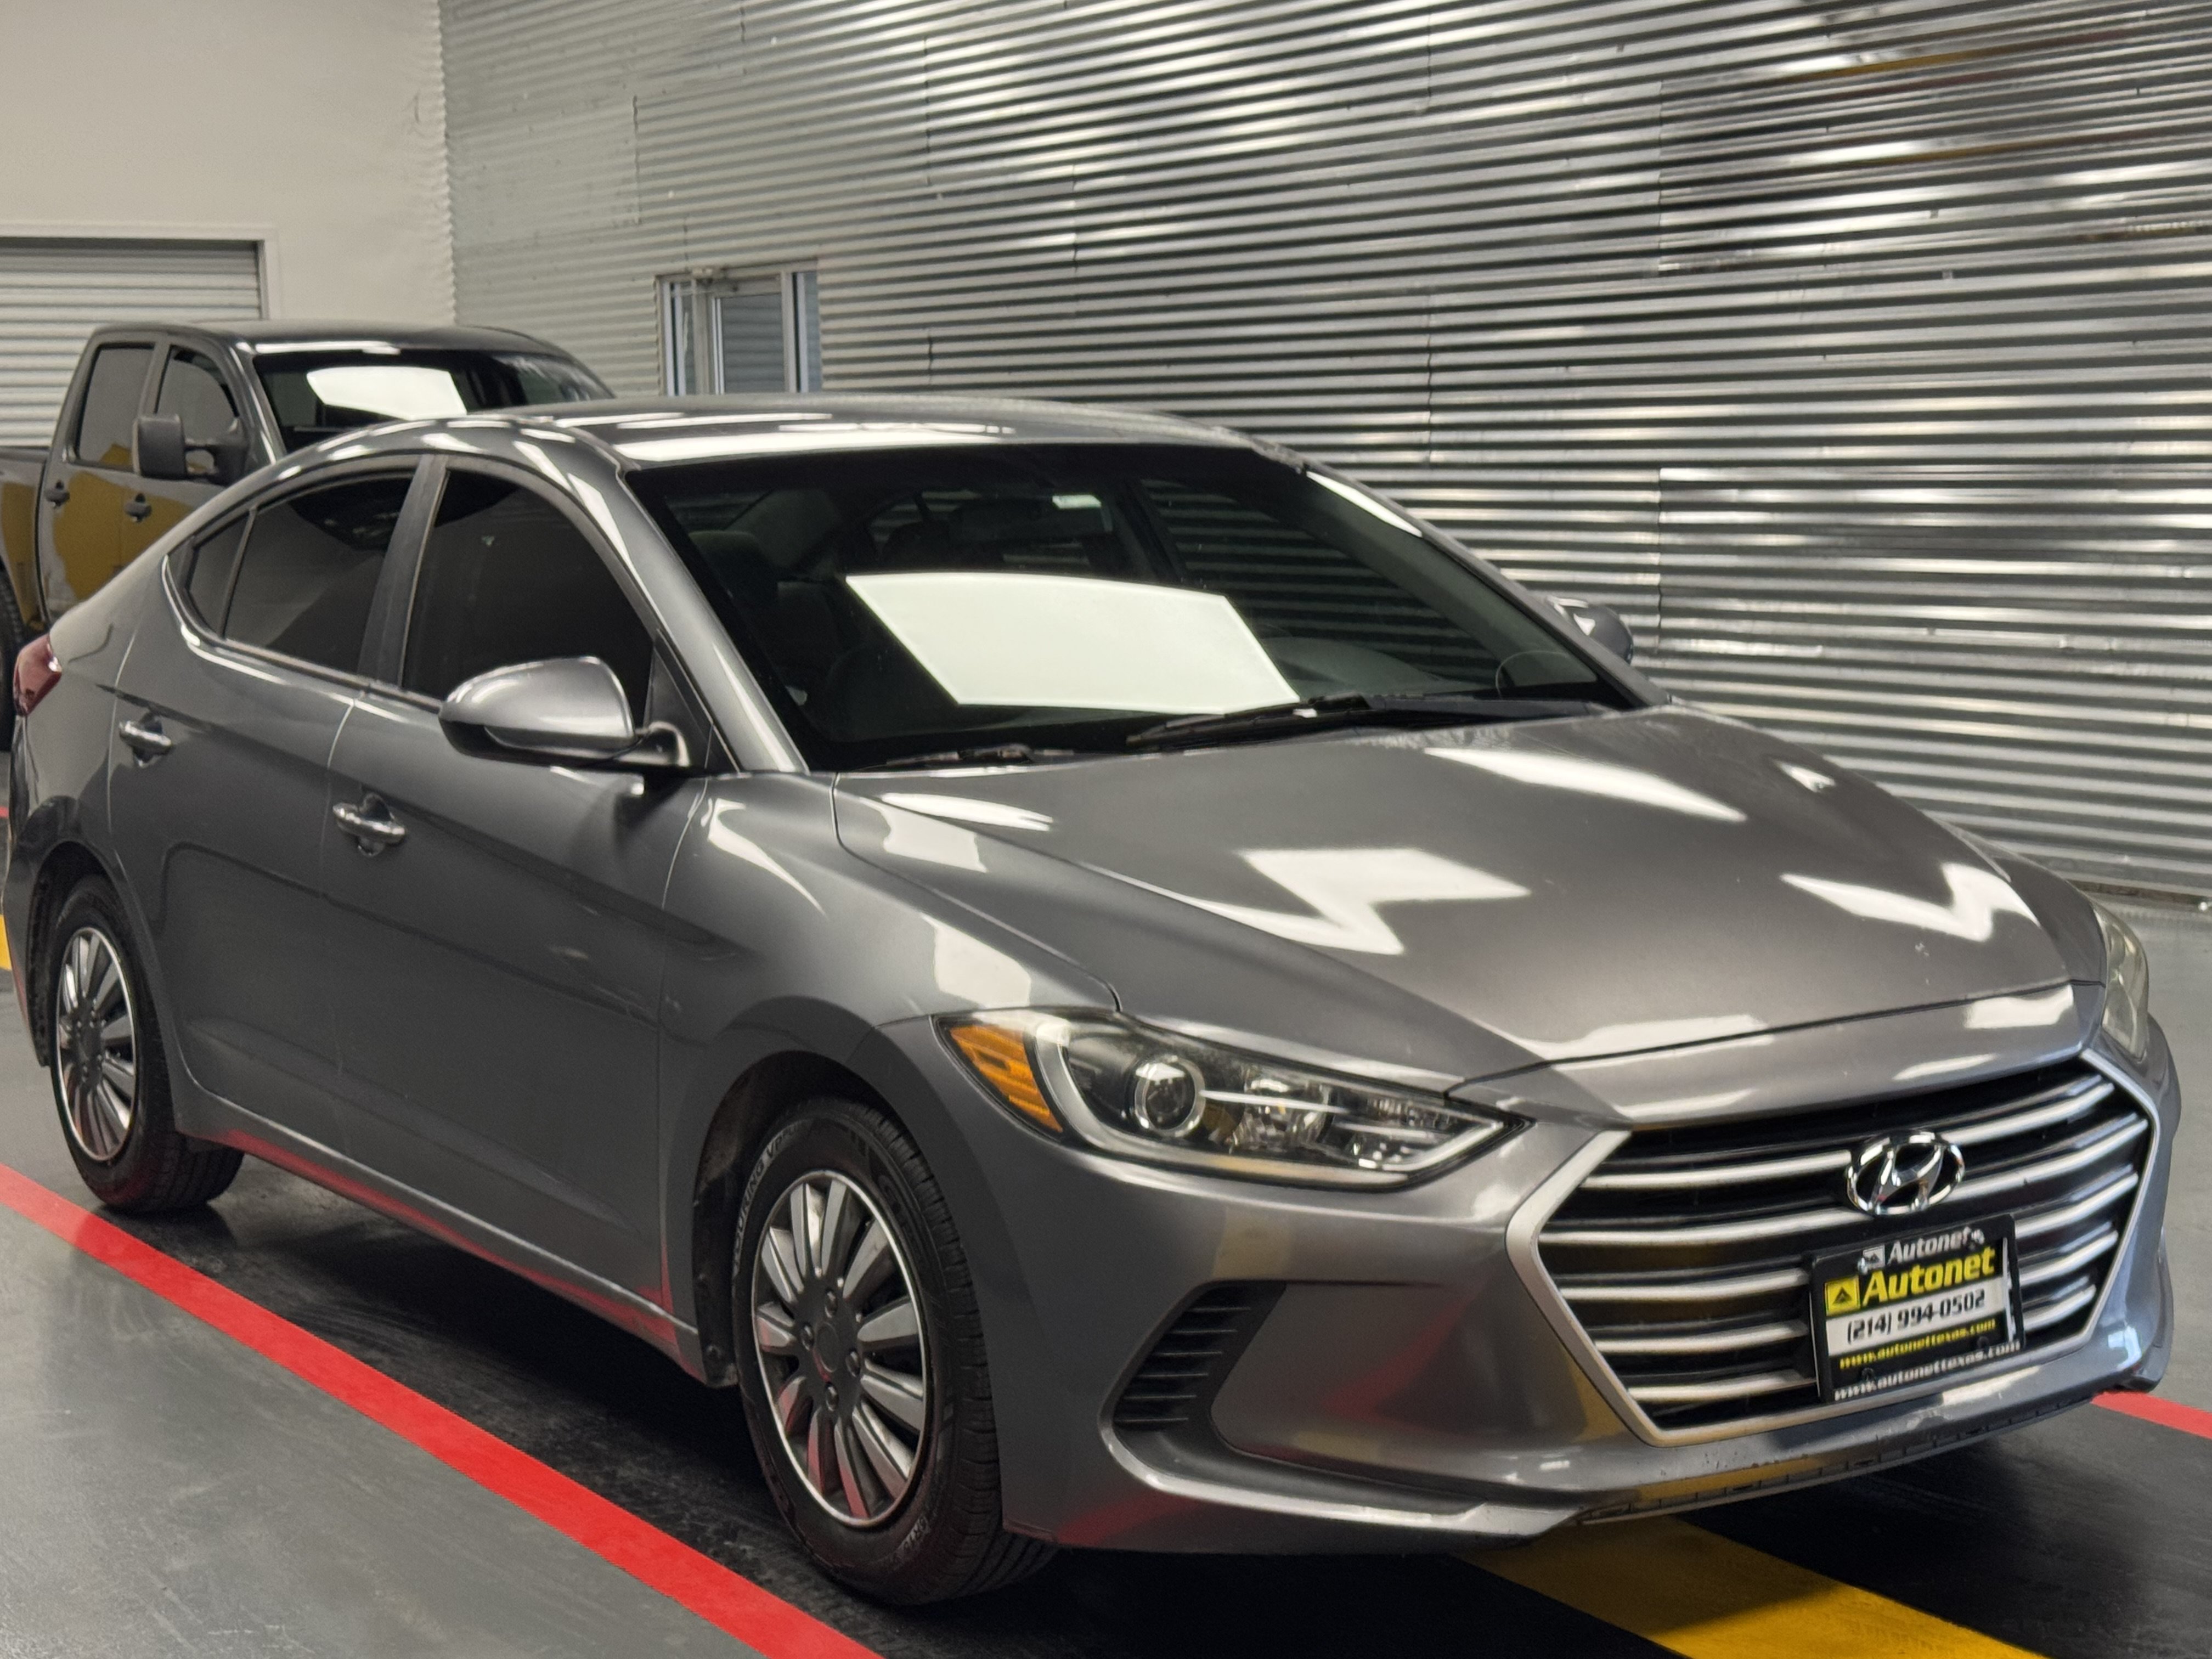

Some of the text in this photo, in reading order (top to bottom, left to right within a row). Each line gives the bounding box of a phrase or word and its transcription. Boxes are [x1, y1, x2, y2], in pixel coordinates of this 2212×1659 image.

[1887, 1226, 1972, 1265] Autonet
[1862, 1246, 1996, 1307] Autonet
[1847, 1288, 1985, 1345] (214) 994-0502
